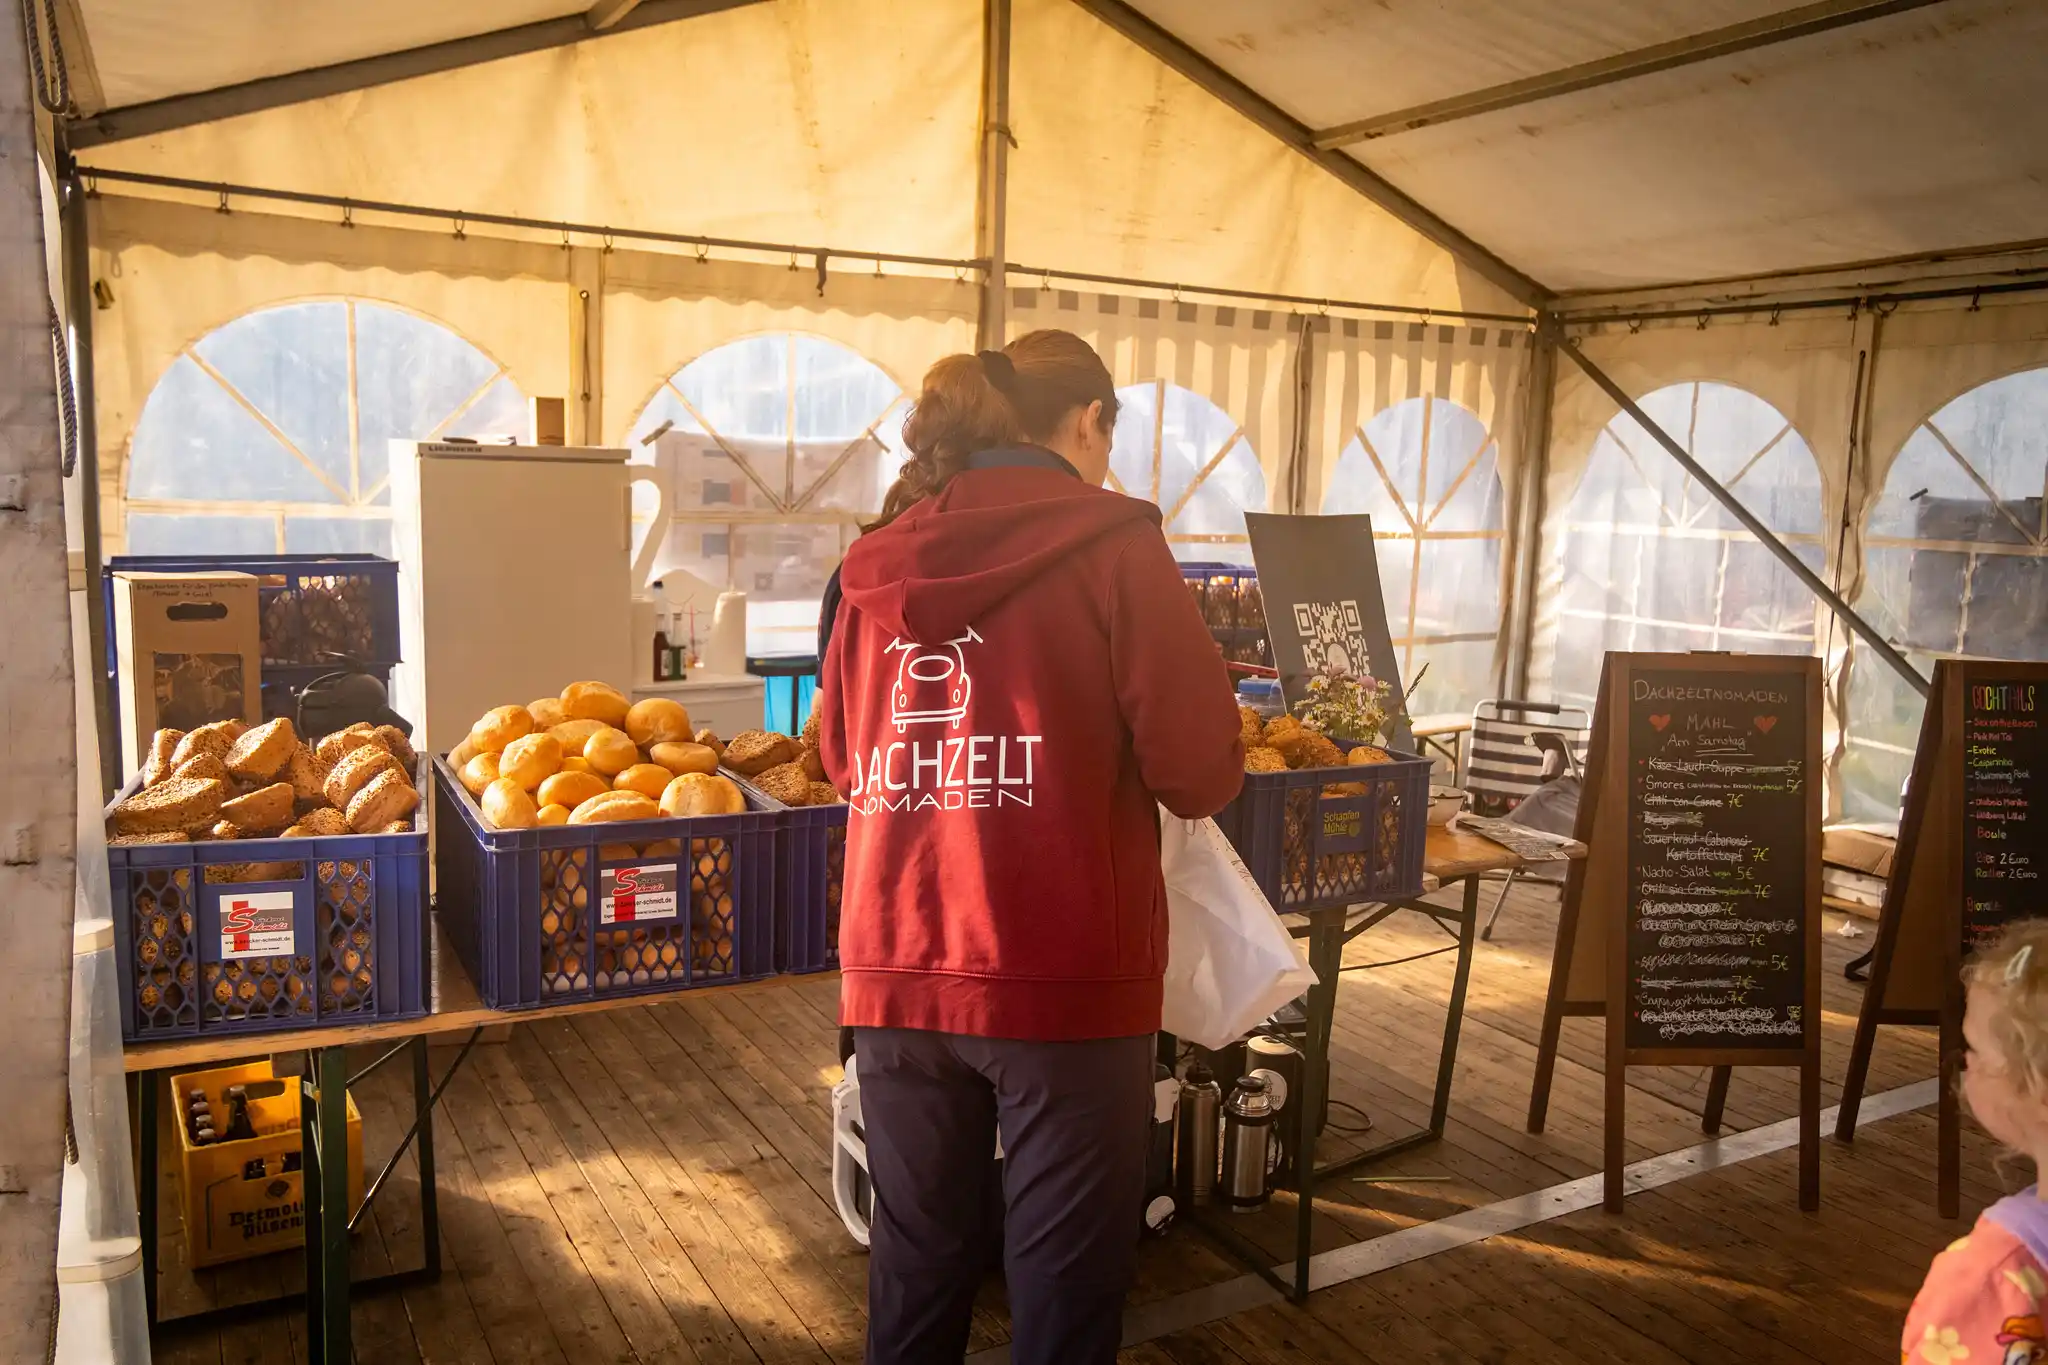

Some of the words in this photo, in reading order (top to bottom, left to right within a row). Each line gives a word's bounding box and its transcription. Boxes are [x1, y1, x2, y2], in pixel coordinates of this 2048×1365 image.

[1633, 679, 1788, 703] DACHZELTNOMADEN
[1686, 713, 1736, 731] MAHL
[1973, 746, 1996, 755] Exotic
[1646, 775, 1685, 790] Smores
[849, 788, 1033, 818] NOMADEN
[1727, 793, 1744, 808] 7€
[1751, 847, 1770, 862] 7€
[1735, 866, 1755, 880] 5€
[1754, 884, 1772, 899] 7€
[606, 897, 672, 909] wwer-schmidt.de
[1771, 954, 1790, 971] 5€
